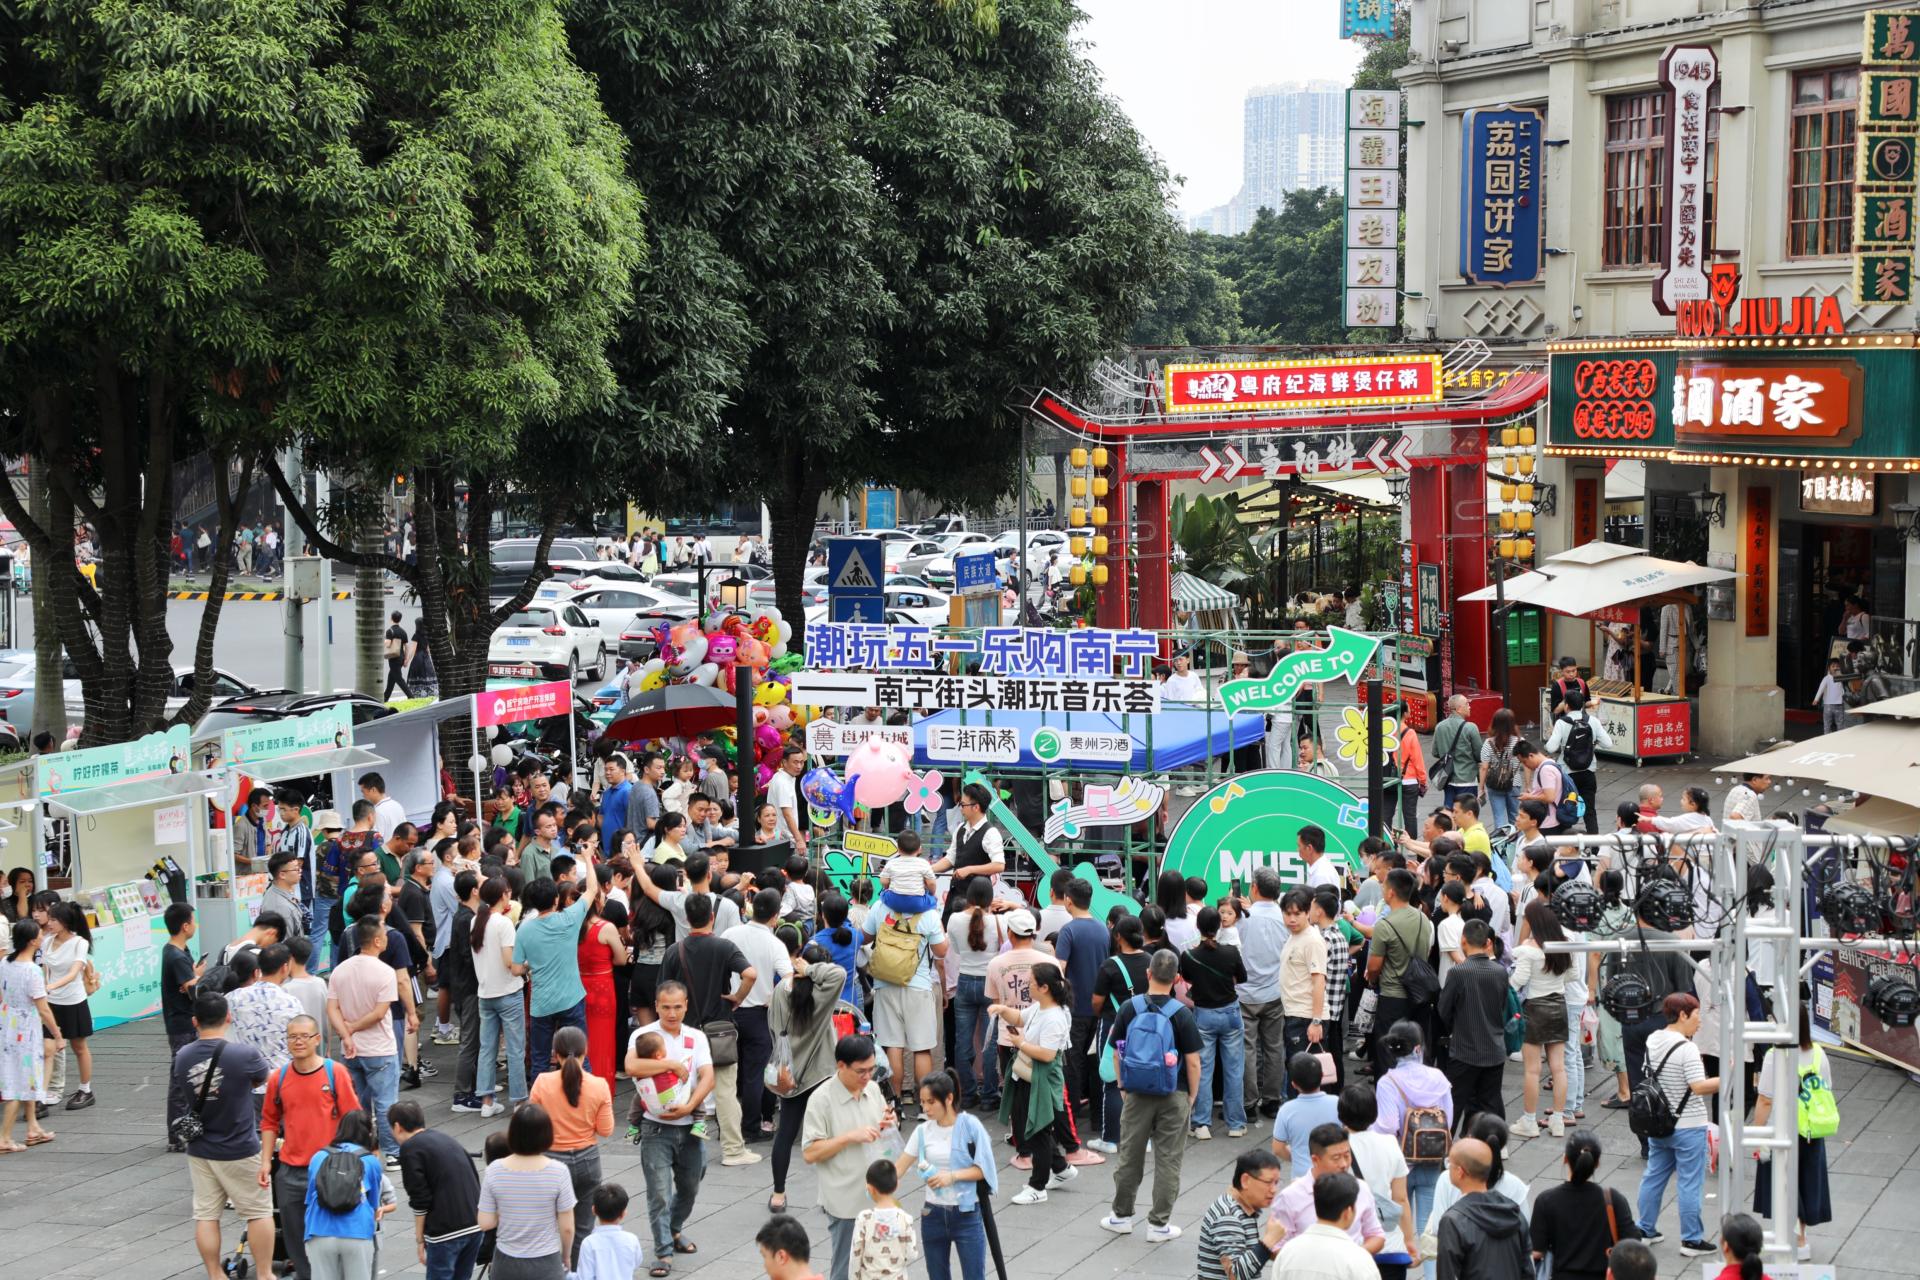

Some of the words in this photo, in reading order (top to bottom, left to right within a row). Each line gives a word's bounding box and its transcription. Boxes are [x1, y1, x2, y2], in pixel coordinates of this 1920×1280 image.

[1673, 61, 1712, 80] 1945
[1519, 121, 1531, 137] LI
[1681, 89, 1700, 175] 食在南宁
[1519, 145, 1531, 190] YUAN
[1356, 94, 1386, 323] 海霸王老友粉
[1483, 120, 1516, 273] 荔园饼家
[1732, 296, 1846, 336] JIUJIA
[1240, 367, 1419, 397] 粤府纪海鲜煲仔粥
[1579, 364, 1655, 394] 广西老字号
[1576, 408, 1653, 435] 创始于1945
[1258, 435, 1355, 474] 当阳街
[963, 562, 992, 579] 民族大道
[1228, 656, 1324, 706] WELCOME
[1330, 650, 1355, 671] TO
[1601, 719, 1627, 738] 友粉
[1642, 735, 1685, 749] 非遗技艺
[1069, 736, 1129, 753] 贵州习酒
[1790, 751, 1856, 767] KFC
[849, 839, 861, 848] GO
[864, 840, 876, 850] GO
[1219, 850, 1346, 889] MUS
[138, 980, 162, 994] 乐购南
